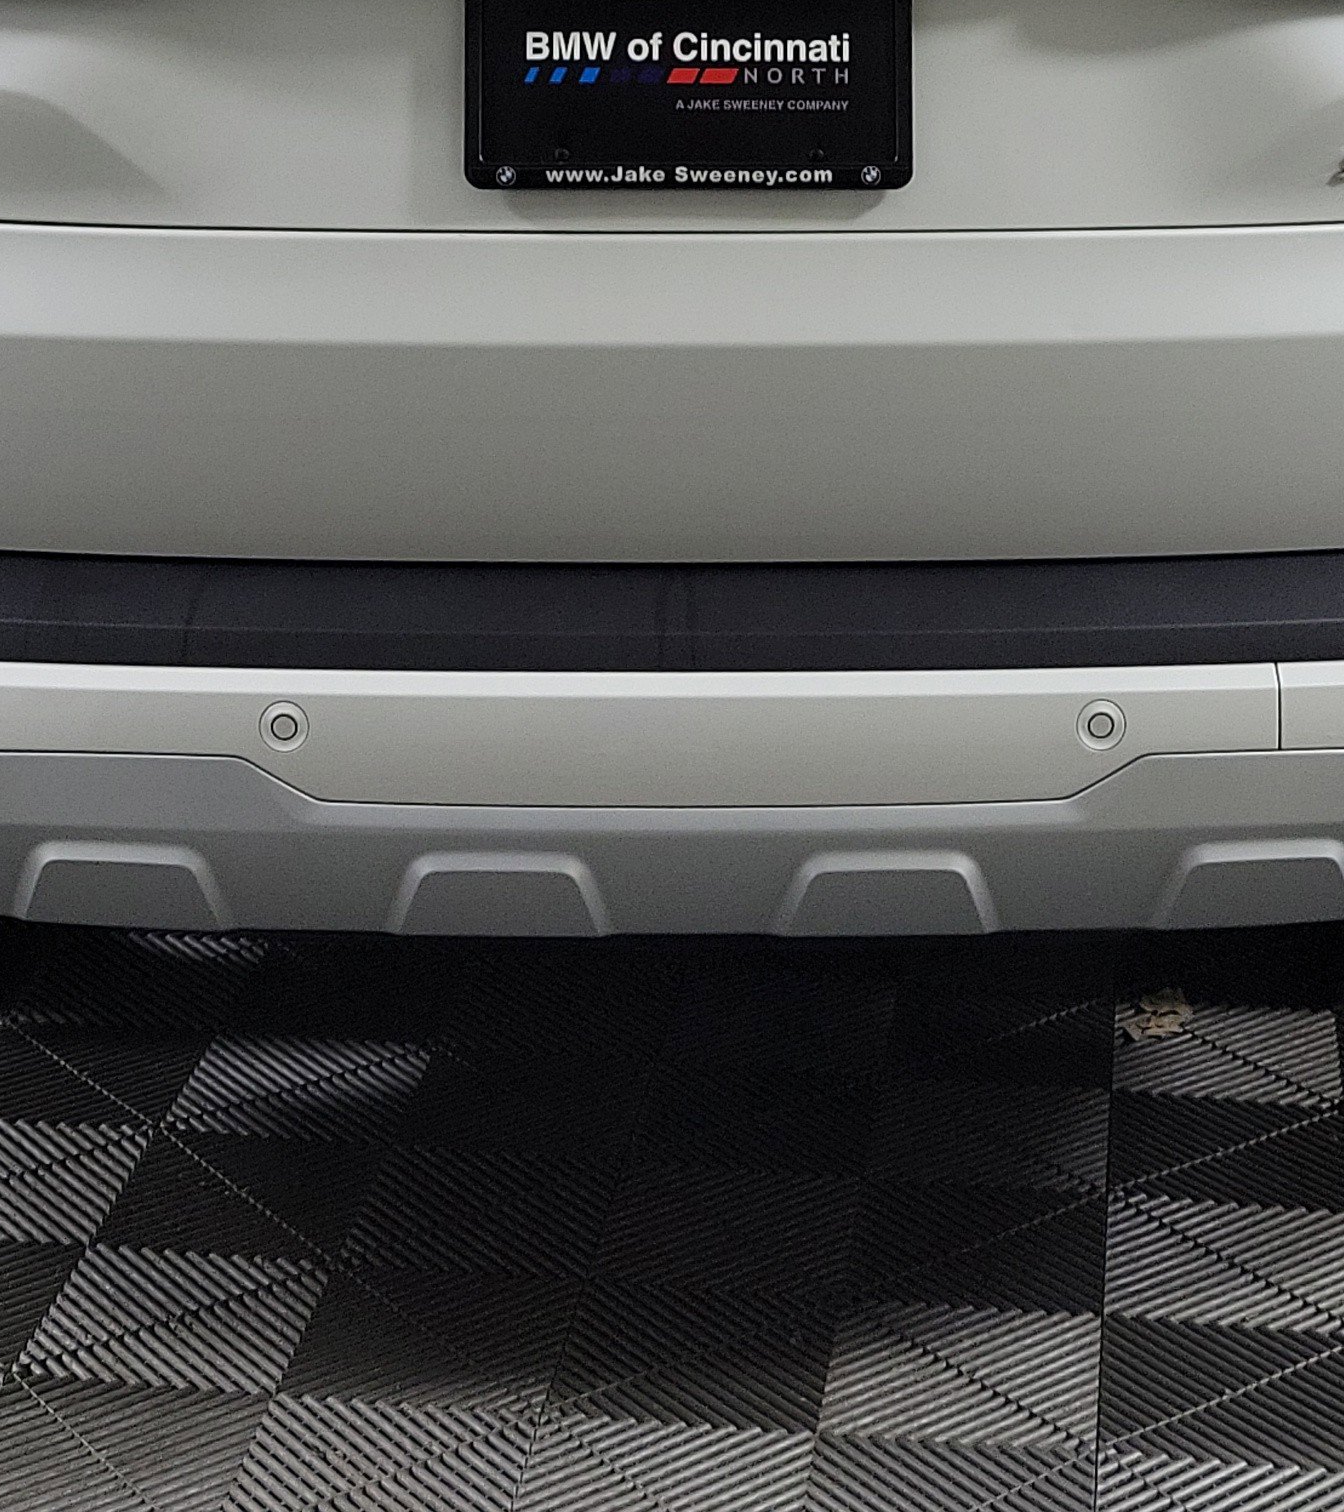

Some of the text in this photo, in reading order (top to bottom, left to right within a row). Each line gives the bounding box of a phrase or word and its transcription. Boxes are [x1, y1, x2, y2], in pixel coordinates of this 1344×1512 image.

[525, 31, 850, 62] BMW of Cincinnati
[743, 67, 849, 85] NORTH
[675, 99, 849, 112] A JAKE SWEENEY COMPANY
[546, 167, 833, 186] www.Jake Sweeney.com
